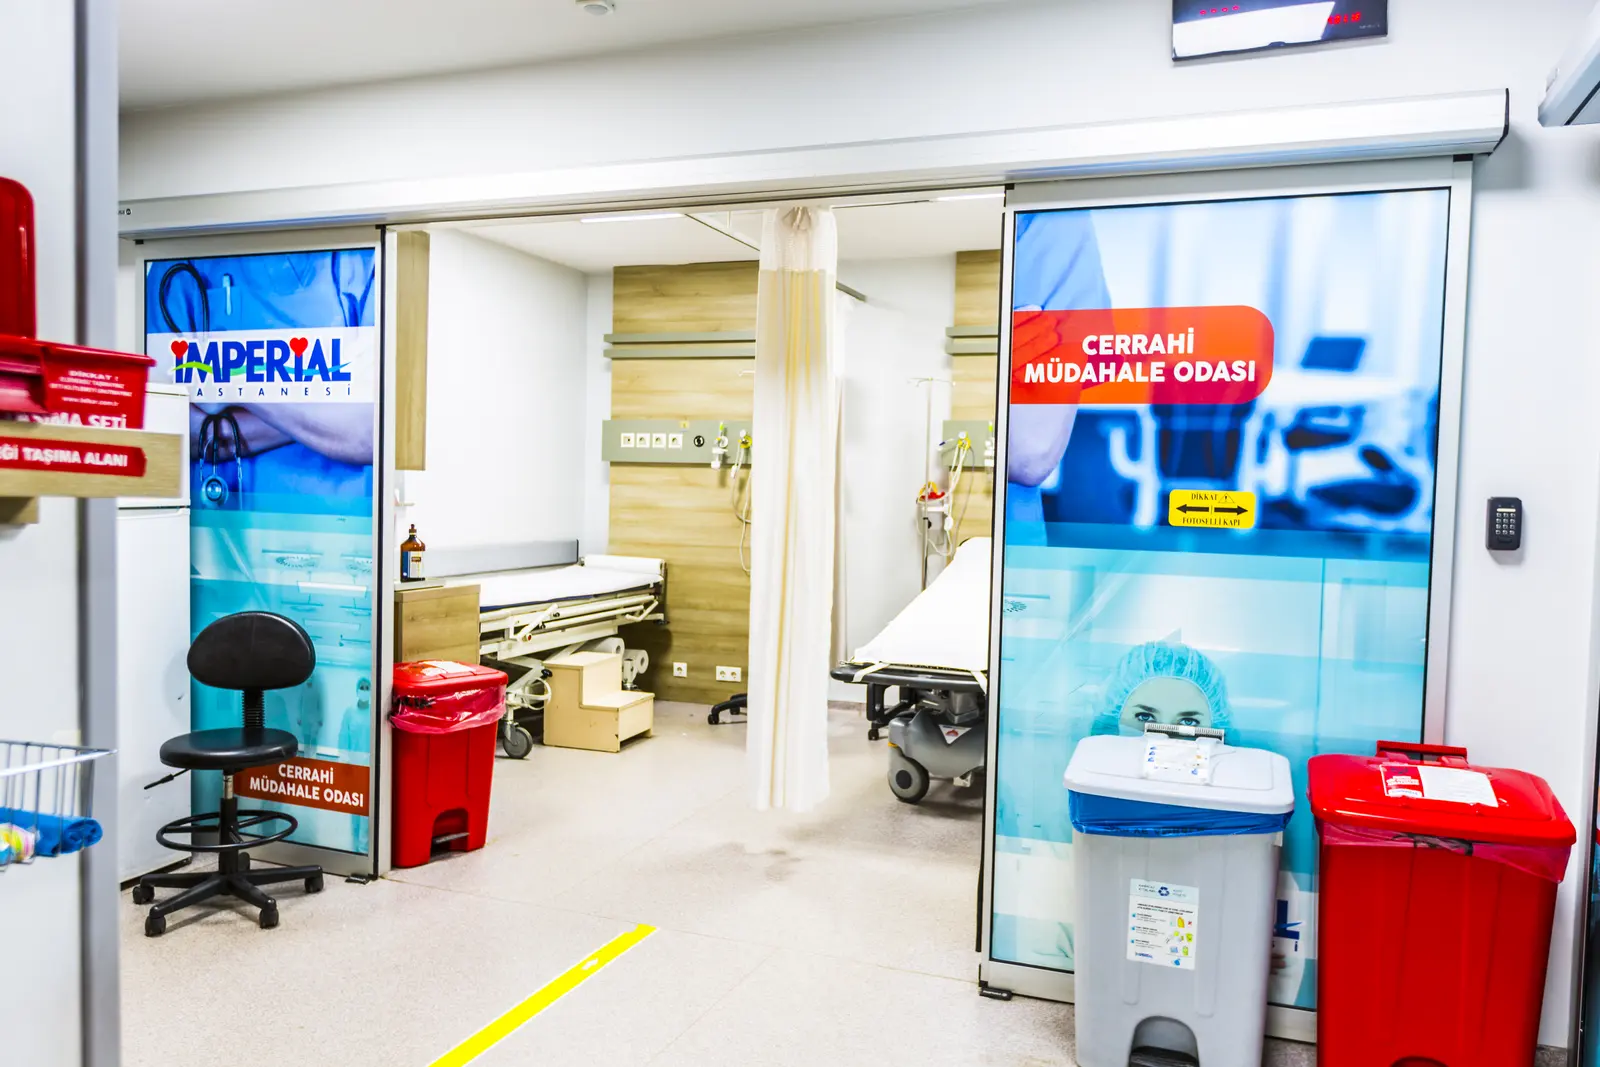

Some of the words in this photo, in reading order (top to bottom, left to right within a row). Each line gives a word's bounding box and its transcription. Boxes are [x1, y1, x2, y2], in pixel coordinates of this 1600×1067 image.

[1082, 328, 1194, 355] CERRAHİ
[1024, 358, 1166, 383] MÜDAHALE
[1173, 360, 1256, 383] ODASI
[197, 383, 352, 397] ASTANESİ
[88, 414, 127, 428] SETİ
[0, 443, 19, 461] Ğİ
[22, 446, 82, 465] TAŞIMA
[84, 451, 128, 467] ALANI
[1191, 493, 1218, 501] DİKKAT
[1223, 518, 1241, 526] KAPI
[278, 763, 334, 785] CERRAHİ
[249, 775, 321, 800] MÜDAHALE
[323, 788, 364, 807] ODASI
